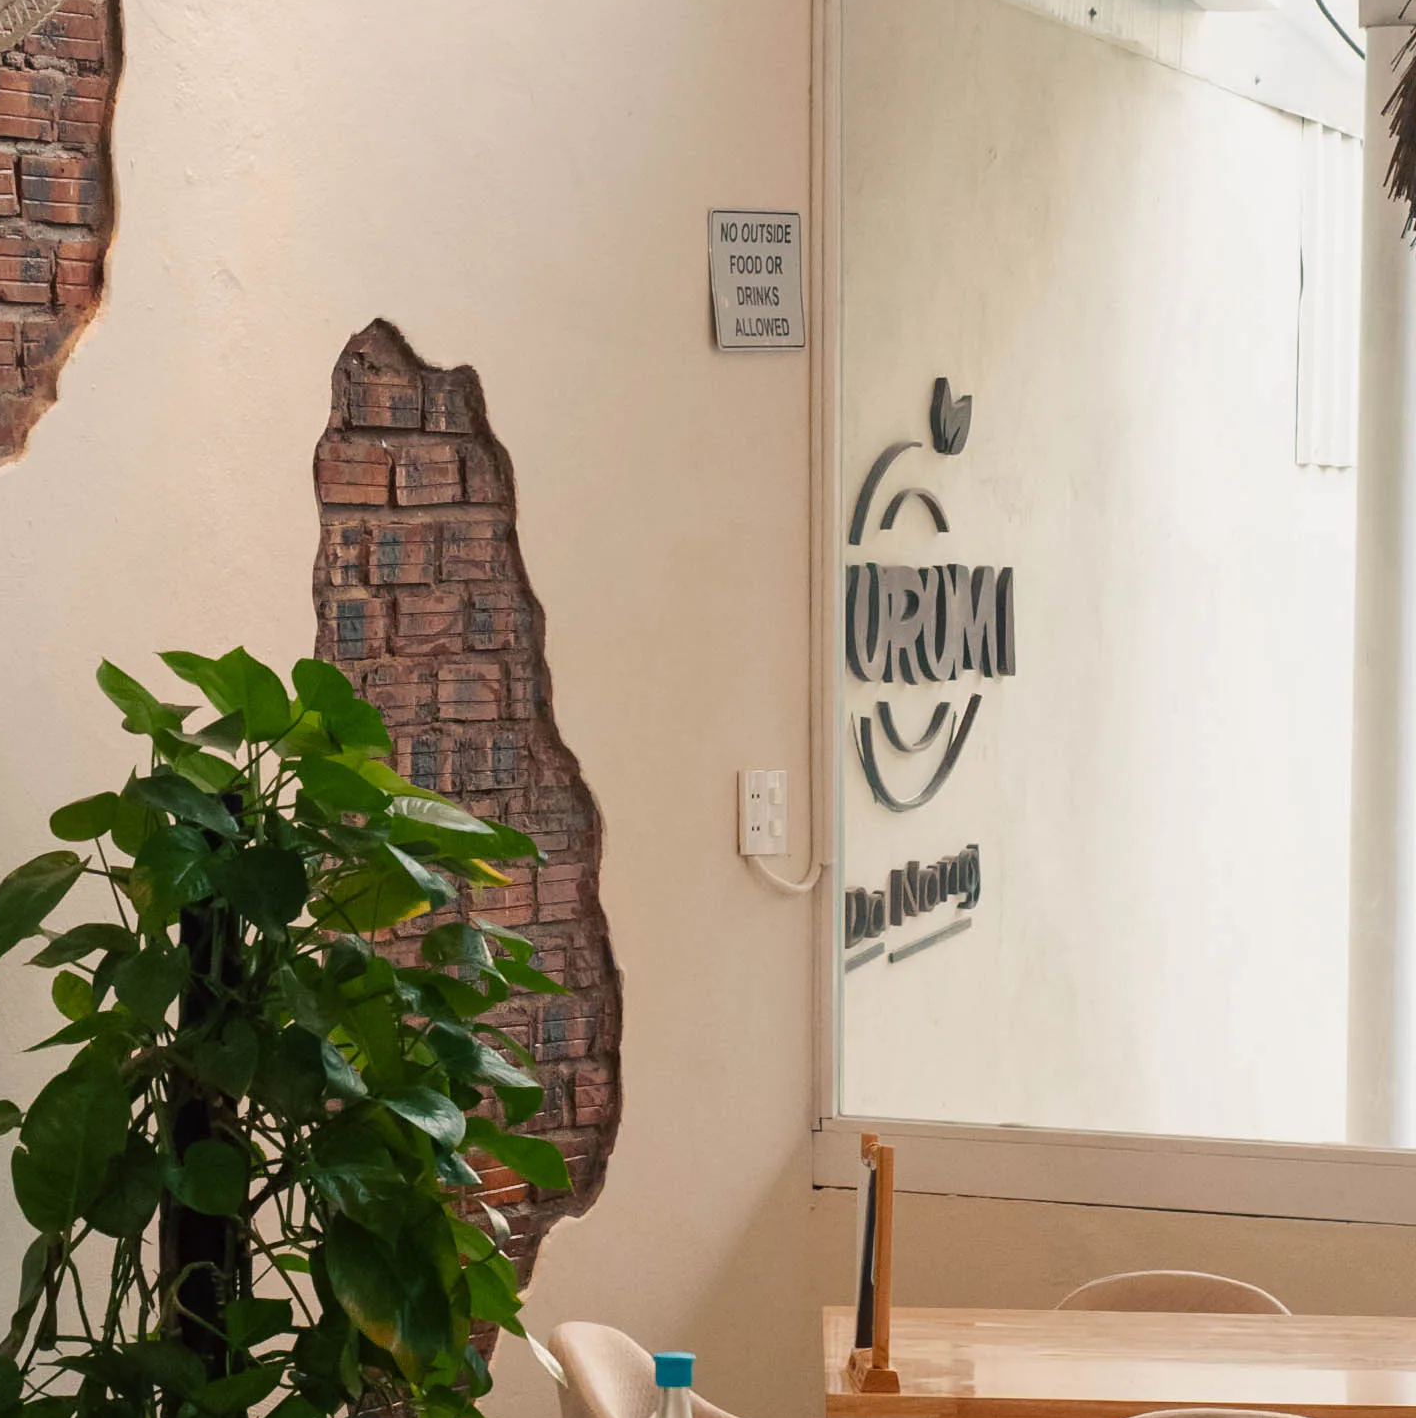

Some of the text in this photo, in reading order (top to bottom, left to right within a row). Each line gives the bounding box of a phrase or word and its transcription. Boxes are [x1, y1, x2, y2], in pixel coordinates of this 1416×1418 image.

[720, 222, 792, 244] NO OUTSIDE
[730, 255, 783, 275] FOOD OR
[737, 286, 780, 306] DRINKS
[735, 317, 790, 337] ALLOWED
[846, 562, 1016, 685] URUMI
[890, 844, 980, 926] Nang
